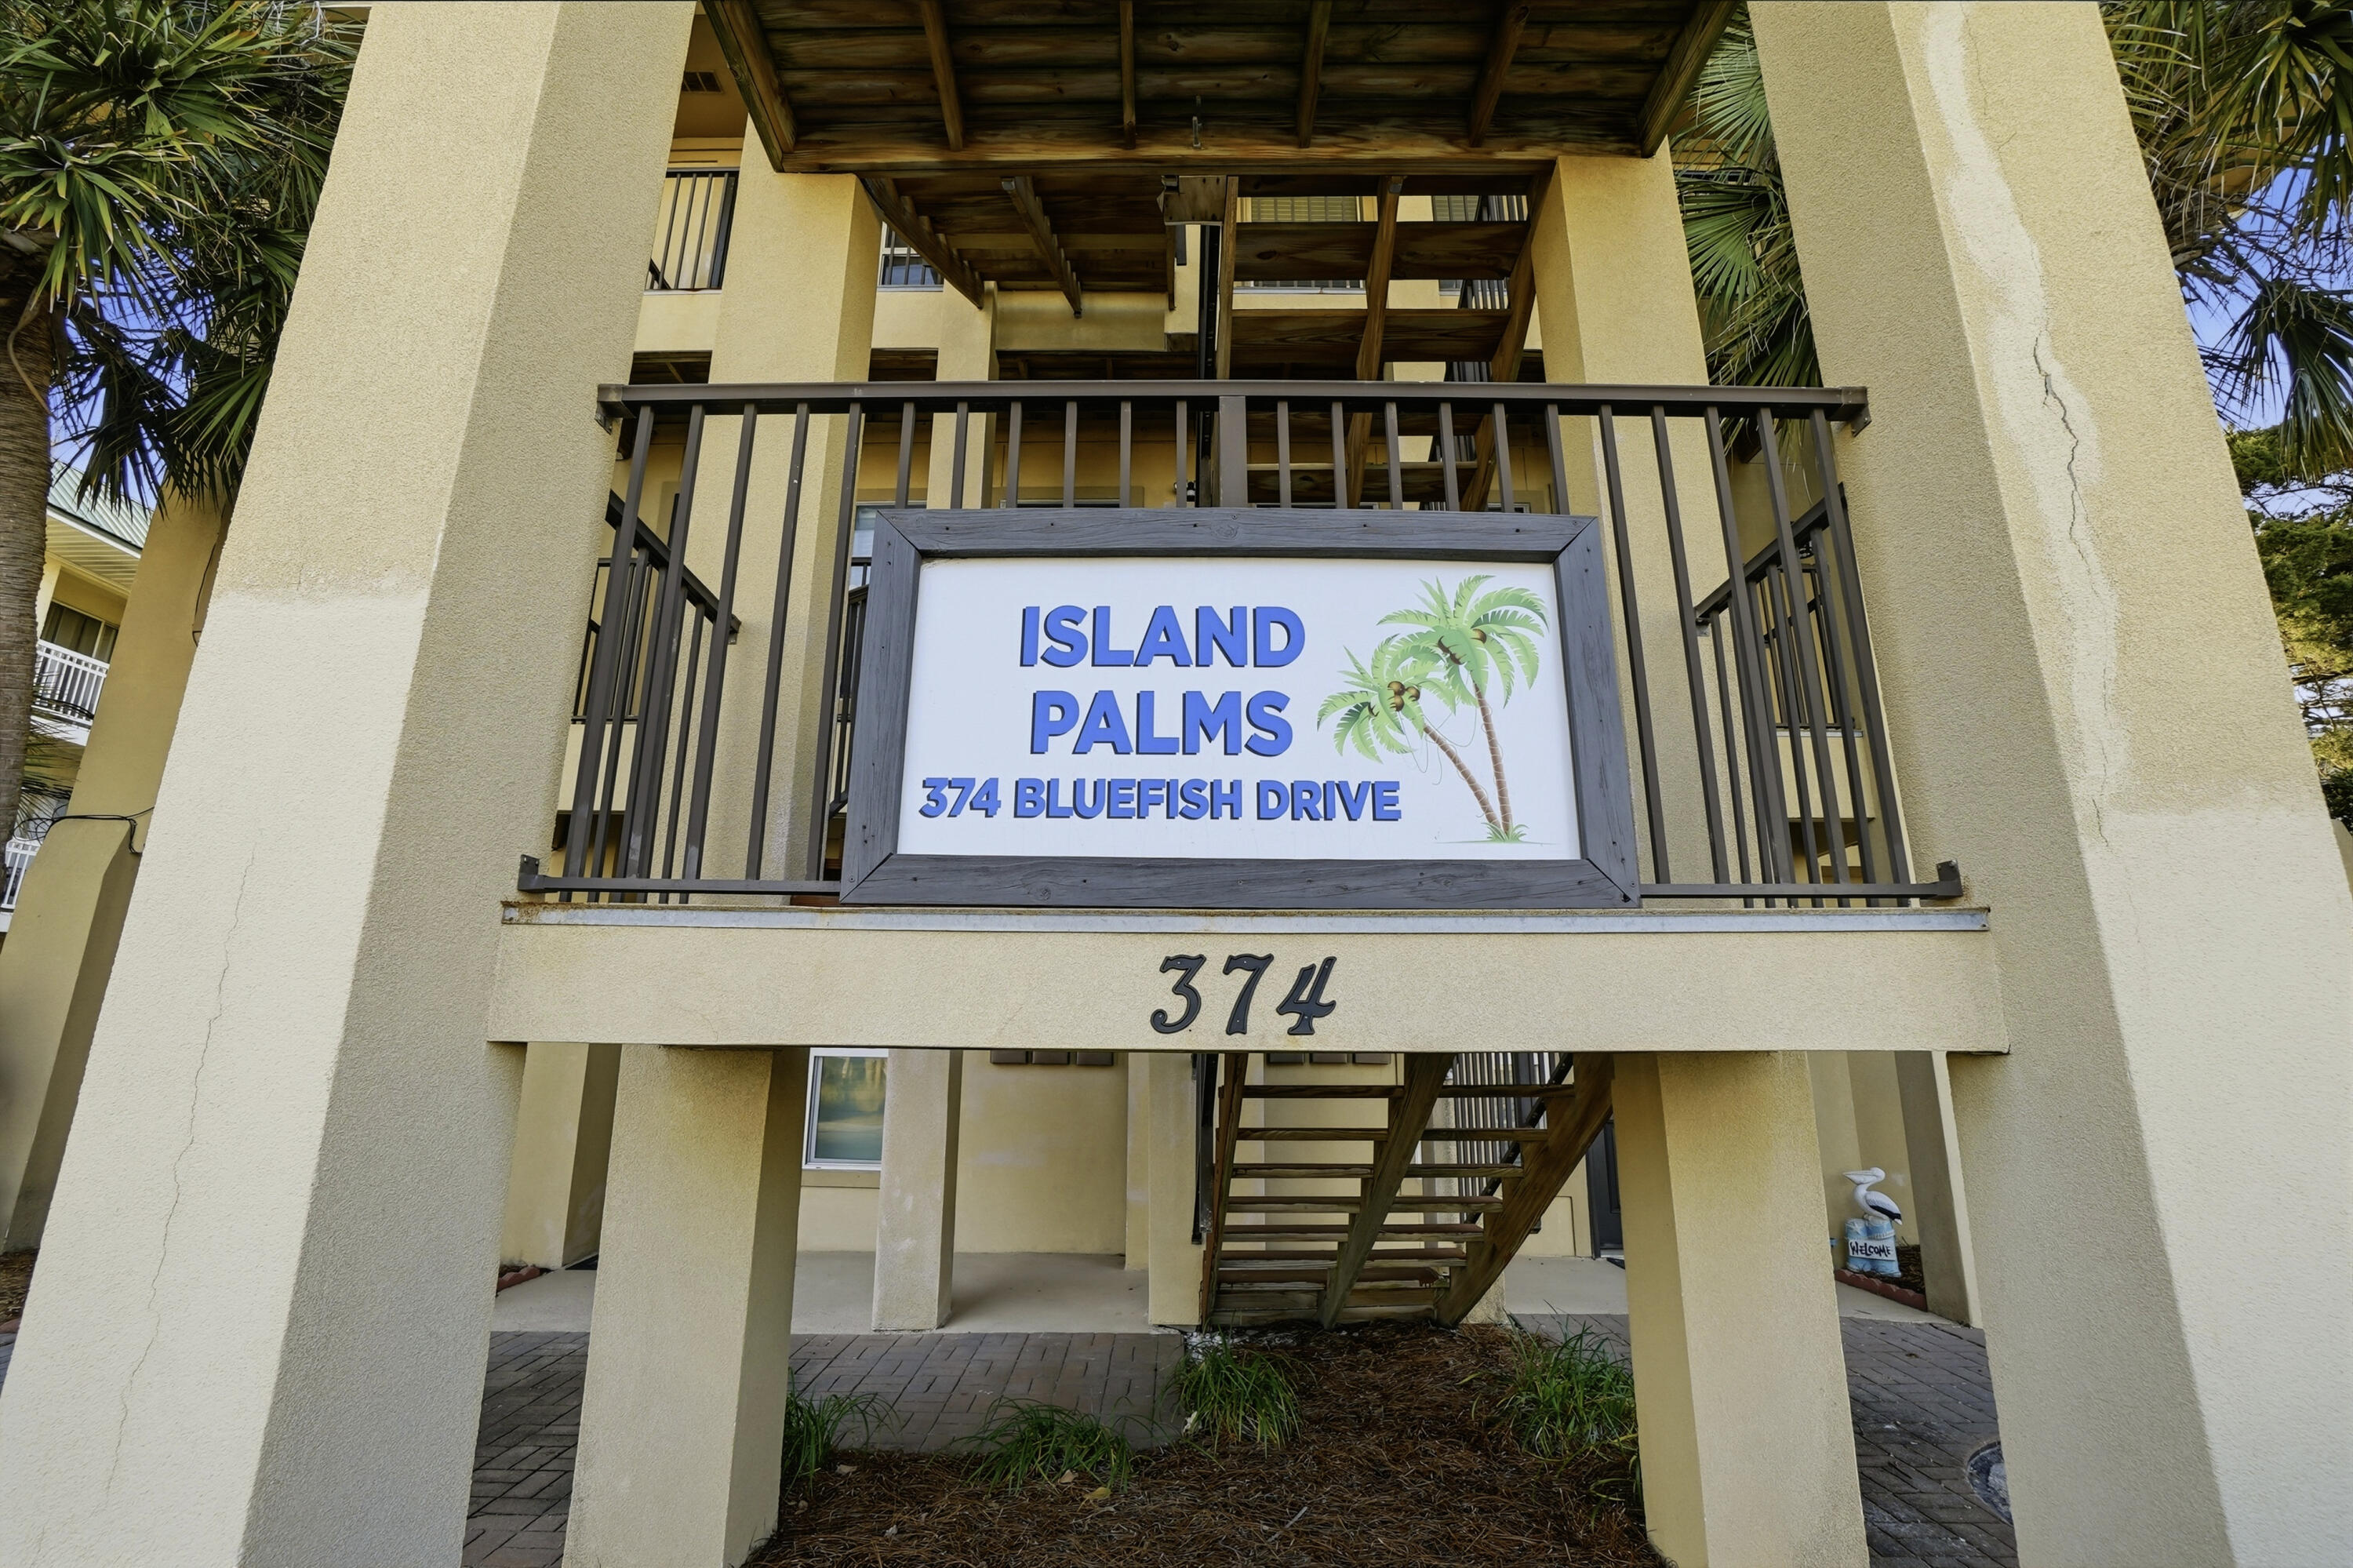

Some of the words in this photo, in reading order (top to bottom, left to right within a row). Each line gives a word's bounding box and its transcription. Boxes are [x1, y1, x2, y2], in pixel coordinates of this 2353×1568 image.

[1020, 605, 1306, 668] ISLAND
[1030, 689, 1294, 757] PALMS
[919, 777, 1002, 819] 374
[1014, 777, 1243, 820] BLUEFISH
[1257, 779, 1402, 821] DRIVE
[1150, 953, 1337, 1036] 374
[1849, 1241, 1891, 1257] WELCOME
